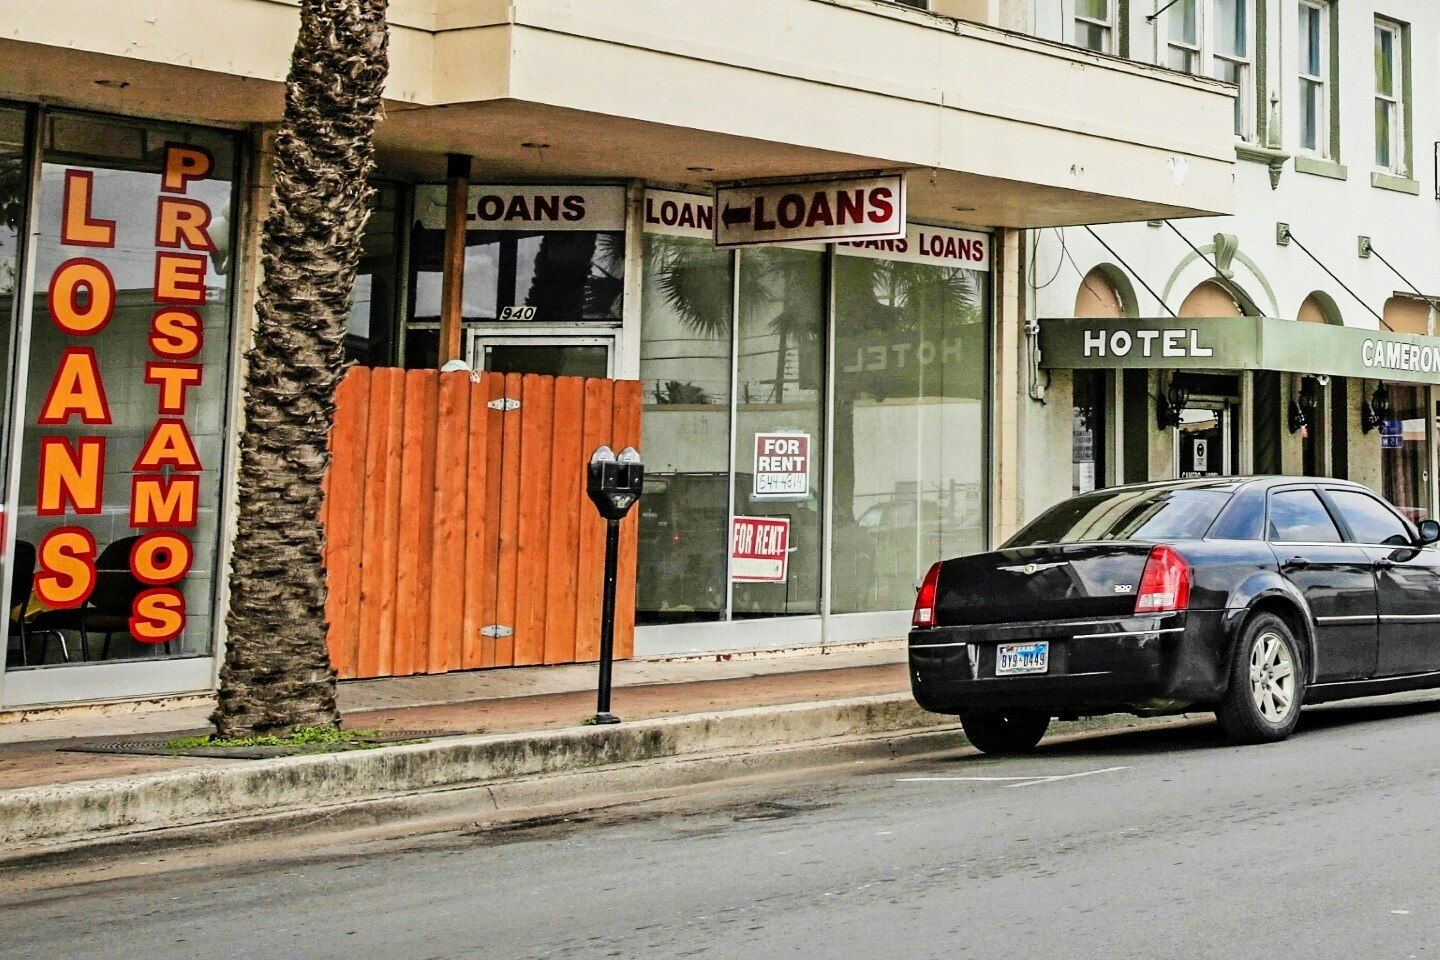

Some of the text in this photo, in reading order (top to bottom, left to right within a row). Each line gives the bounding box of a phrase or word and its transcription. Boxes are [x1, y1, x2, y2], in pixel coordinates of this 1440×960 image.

[754, 187, 893, 231] LOANS
[919, 233, 984, 262] LOANS
[502, 306, 534, 320] 940
[1083, 330, 1213, 357] HOTEL
[34, 168, 117, 608] LOANS
[129, 141, 218, 644] PRESTAMOS
[764, 439, 799, 455] FOR
[758, 456, 805, 472] RENT
[733, 522, 785, 557] FOR RENT
[1114, 584, 1132, 593] 300
